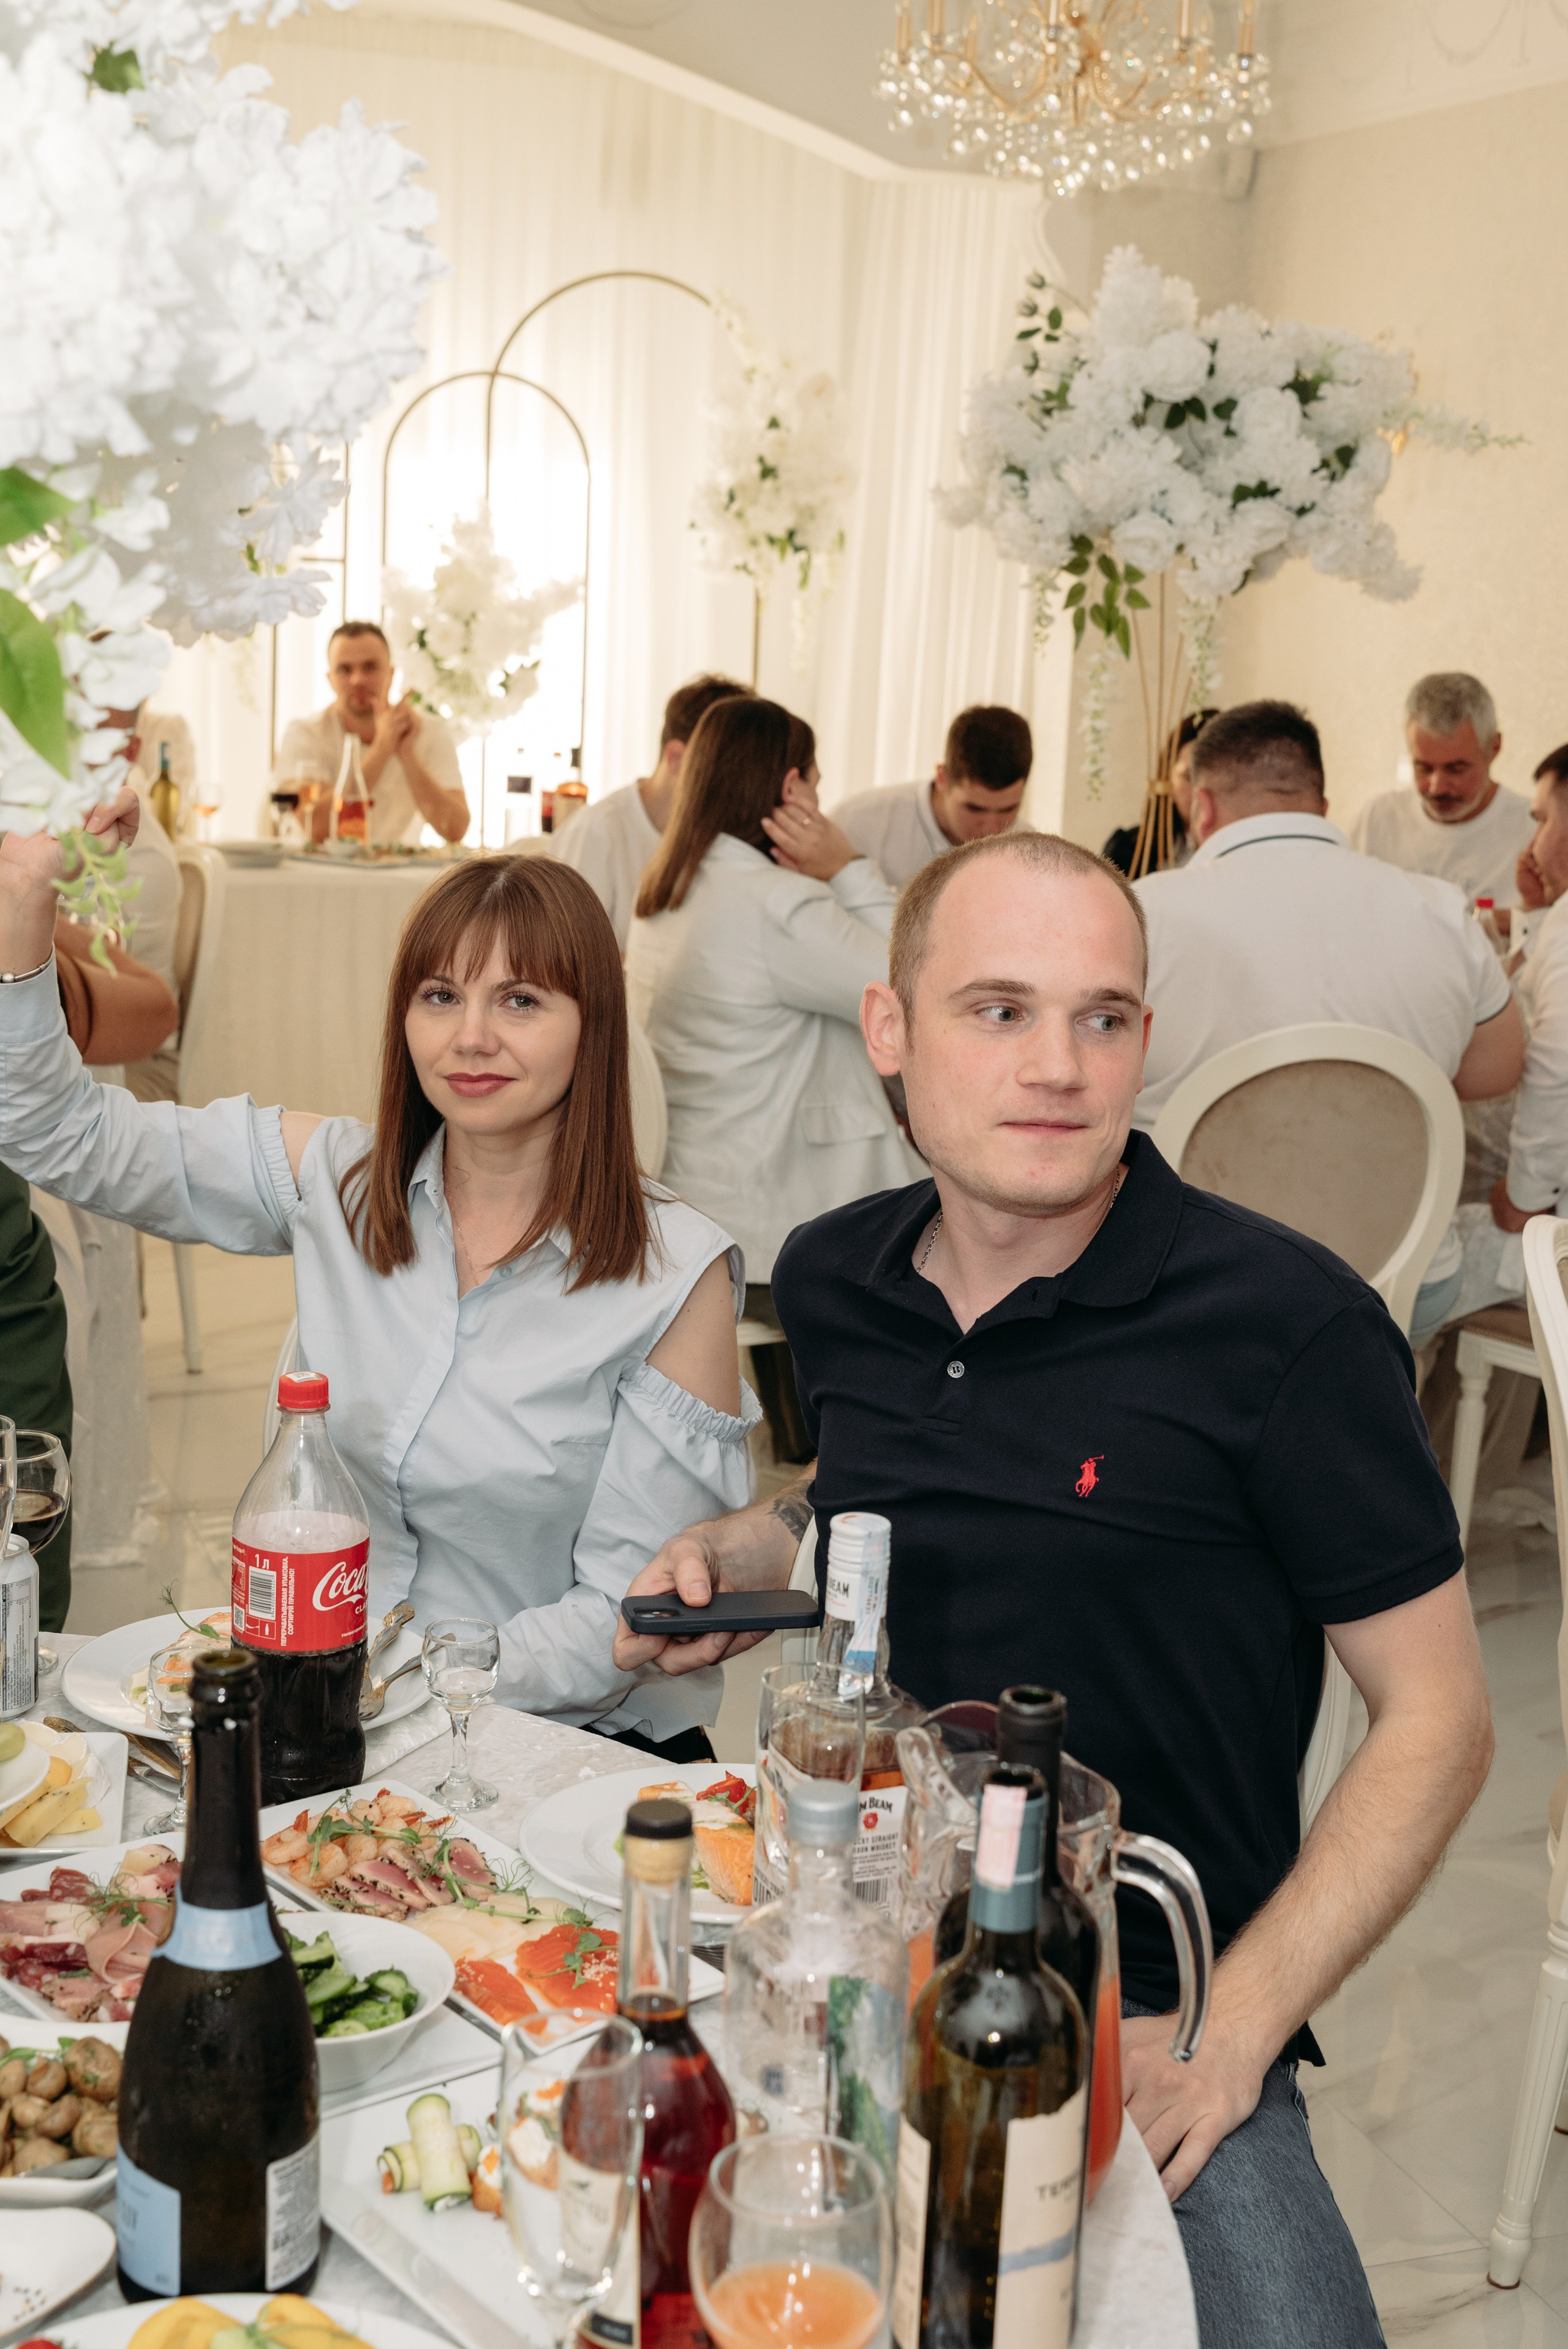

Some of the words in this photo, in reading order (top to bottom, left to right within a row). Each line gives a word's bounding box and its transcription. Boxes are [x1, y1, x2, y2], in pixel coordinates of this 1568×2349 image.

[255, 1554, 259, 1567] 1
[262, 1559, 269, 1569] л
[869, 1797, 892, 1813] BEAM
